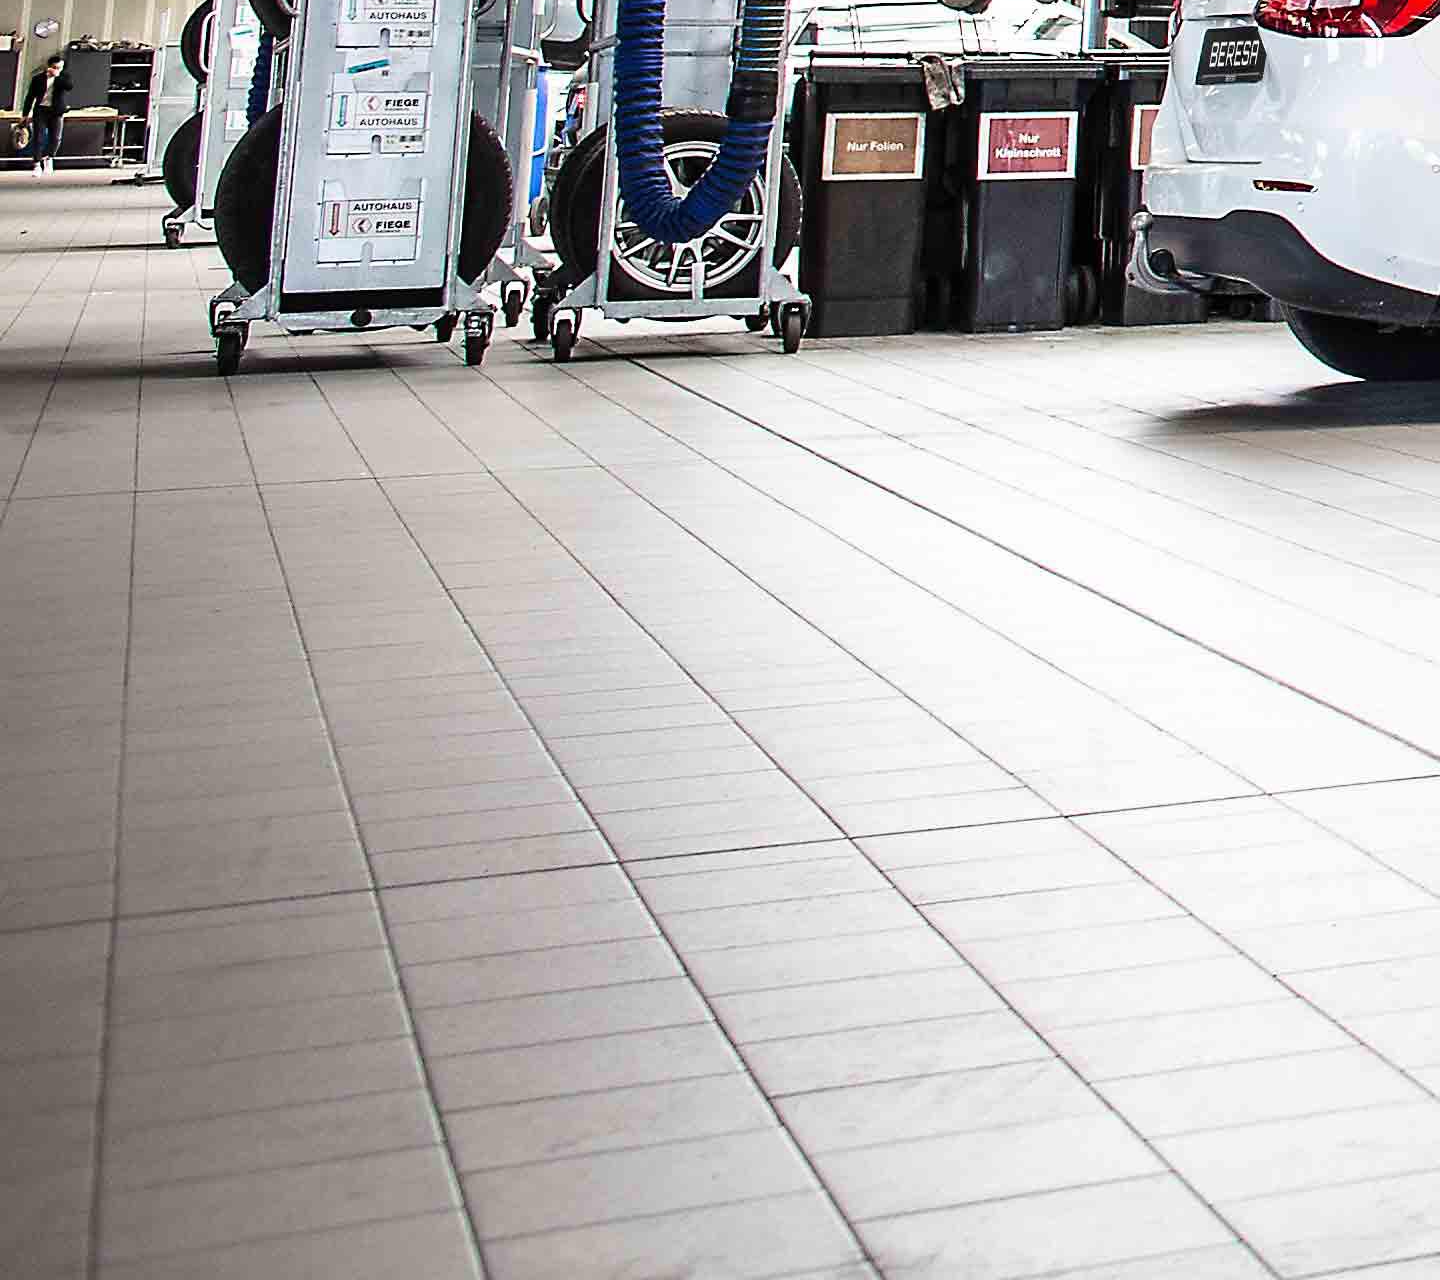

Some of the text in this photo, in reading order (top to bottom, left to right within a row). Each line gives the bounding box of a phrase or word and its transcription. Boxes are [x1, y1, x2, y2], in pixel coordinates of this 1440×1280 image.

[369, 12, 427, 20] AUTOHAUS
[1209, 40, 1260, 68] BERESA
[385, 99, 419, 107] FIEGE
[359, 118, 418, 126] AUTOHAUS
[1018, 133, 1041, 144] Nur
[847, 140, 904, 152] Nur Folien
[995, 146, 1062, 159] Kleinschrott
[353, 202, 412, 211] AUTOHAUS
[375, 220, 411, 229] FIEGE
